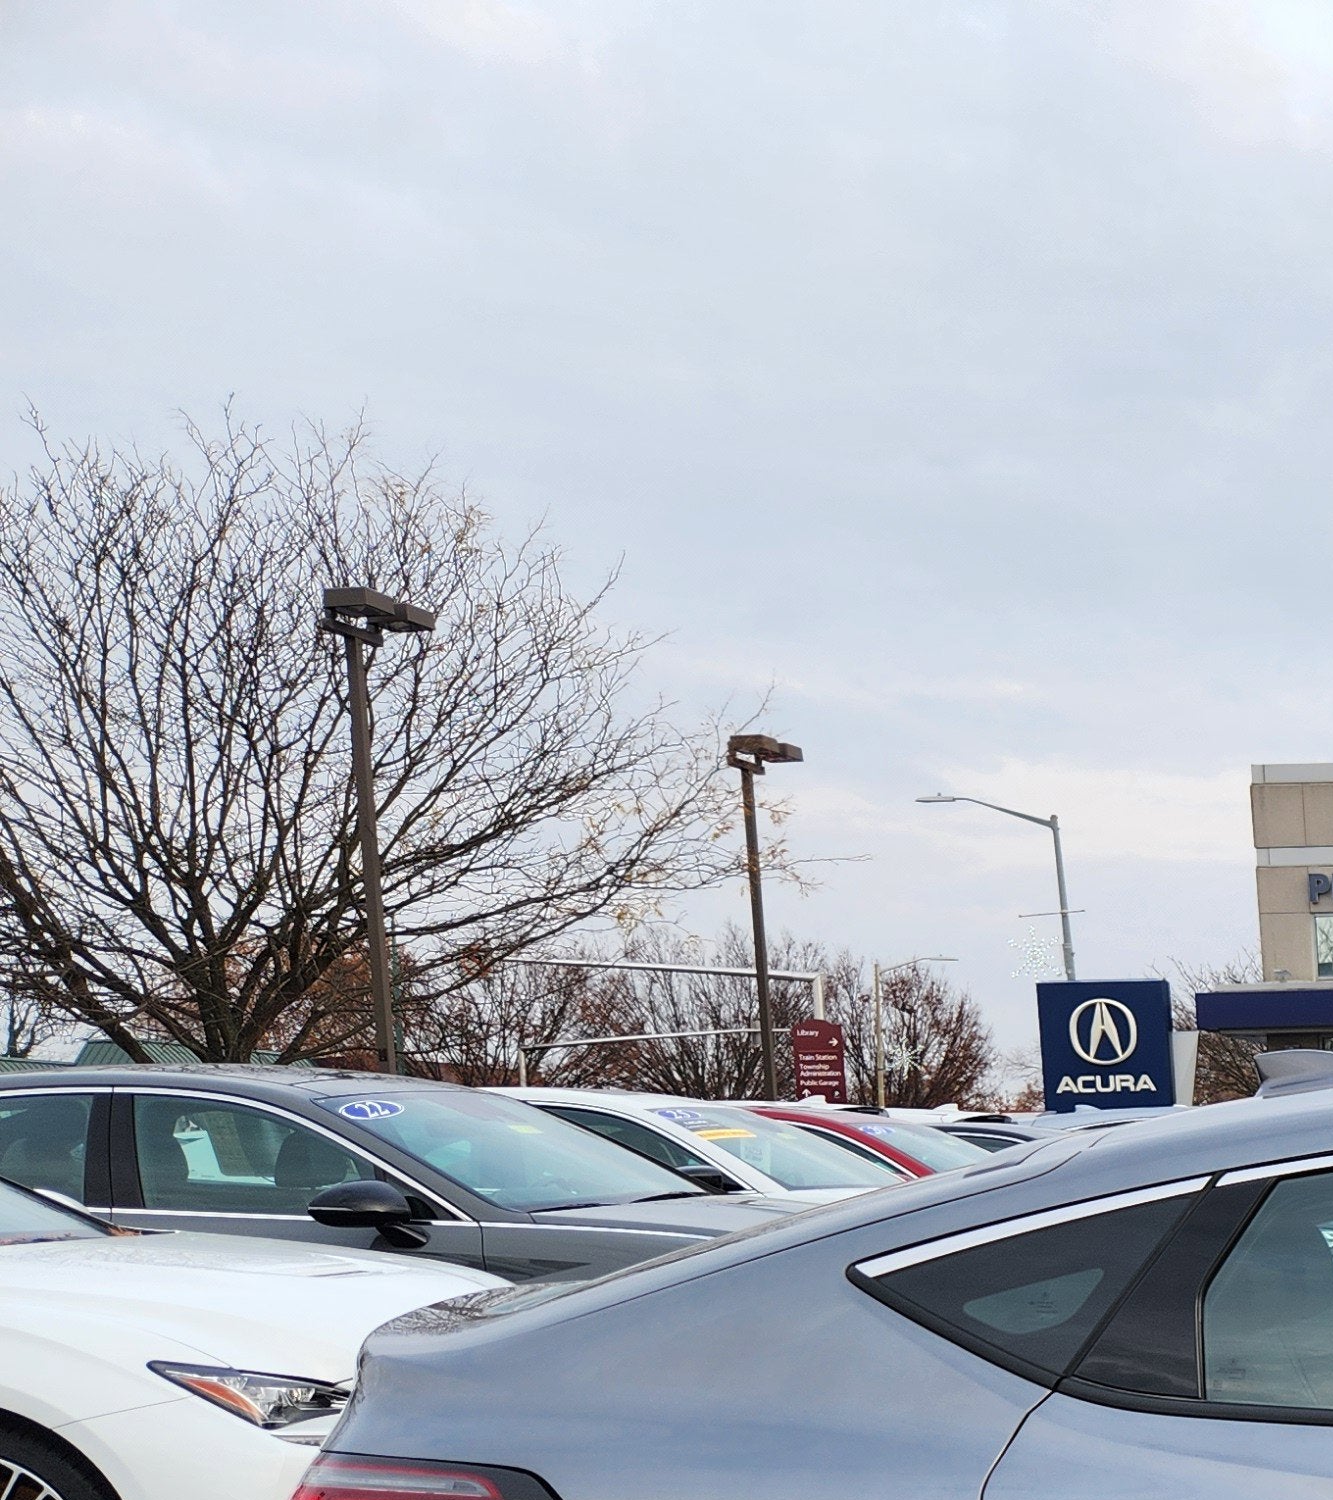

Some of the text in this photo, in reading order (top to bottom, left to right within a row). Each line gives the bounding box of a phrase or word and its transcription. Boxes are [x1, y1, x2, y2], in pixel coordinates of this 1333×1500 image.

[797, 1029, 819, 1037] Library
[799, 1053, 838, 1061] Train Station
[799, 1063, 830, 1071] Township
[819, 1079, 839, 1087] Garage
[1055, 1074, 1157, 1094] ACURA
[355, 1101, 390, 1118] 22
